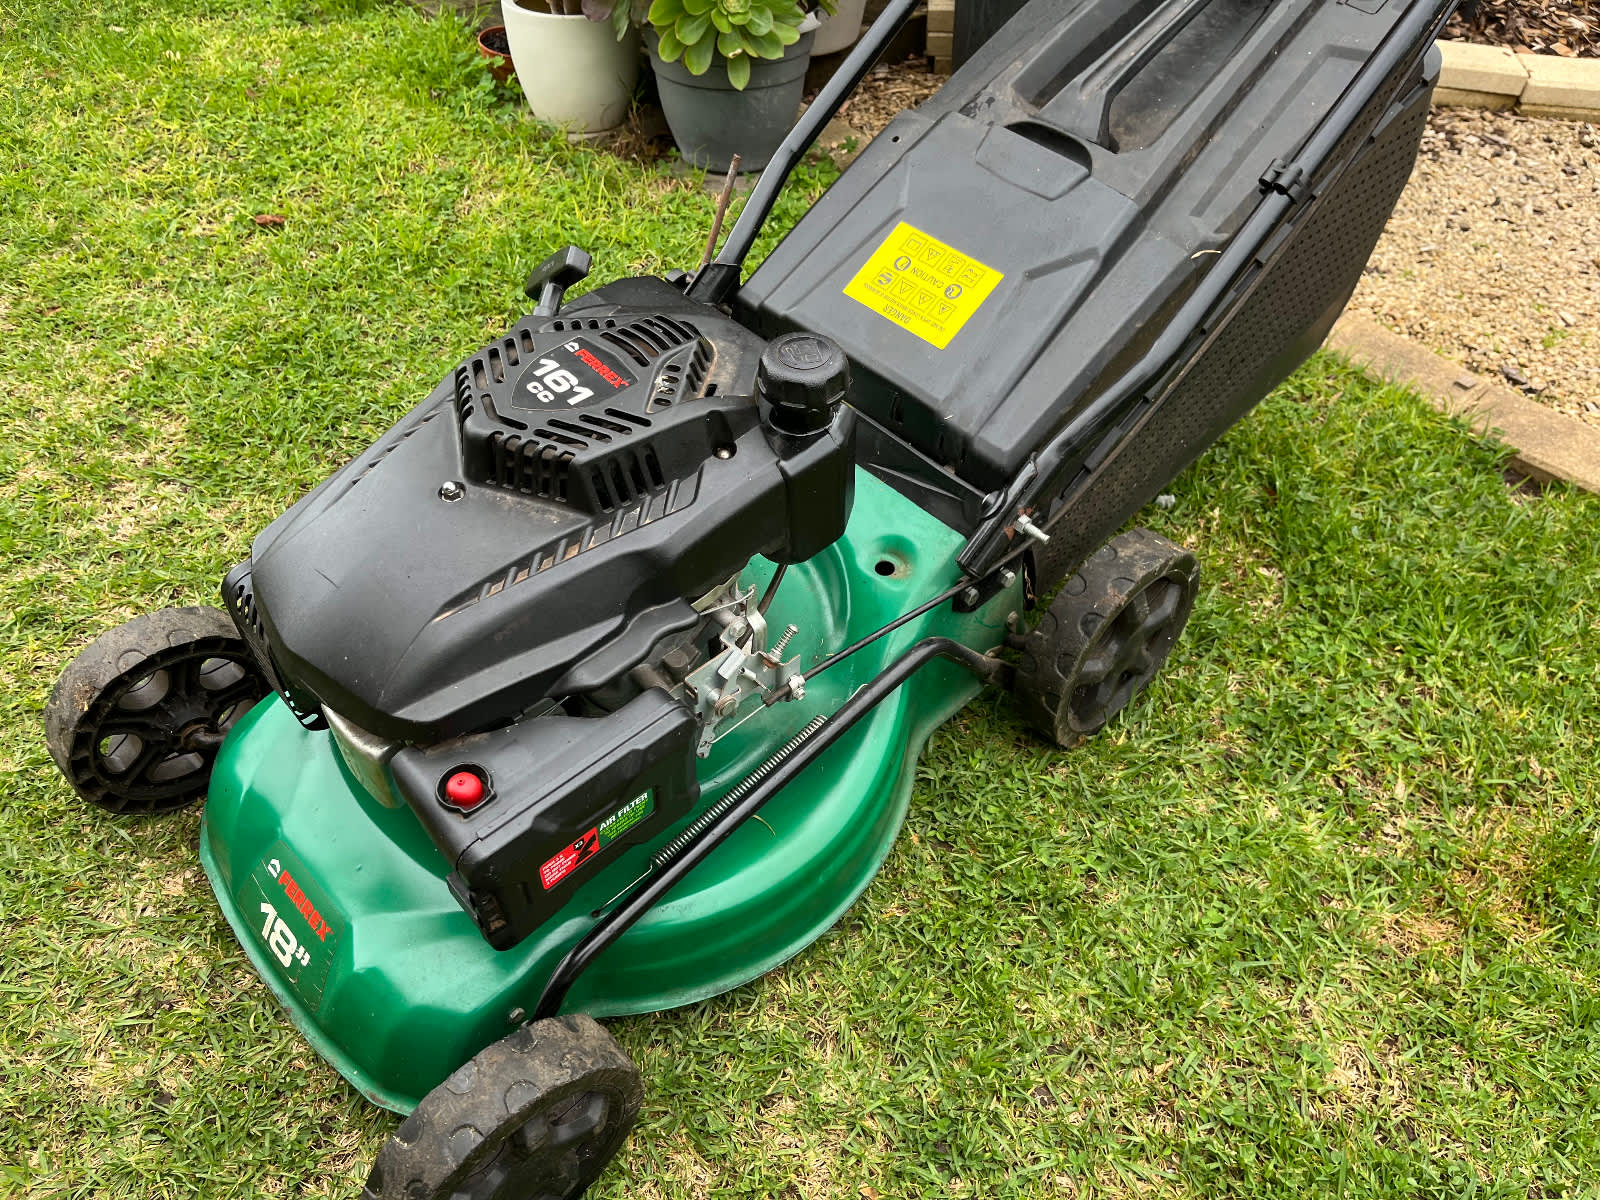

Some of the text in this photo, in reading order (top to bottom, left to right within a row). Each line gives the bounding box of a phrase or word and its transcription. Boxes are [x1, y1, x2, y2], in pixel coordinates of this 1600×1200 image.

[910, 267, 945, 289] CAUTION
[883, 303, 912, 324] DANGER
[533, 358, 594, 405] 161
[574, 349, 630, 388] FERREX
[599, 815, 616, 831] AIR
[618, 792, 648, 816] FILTER
[278, 870, 333, 942] FERREX
